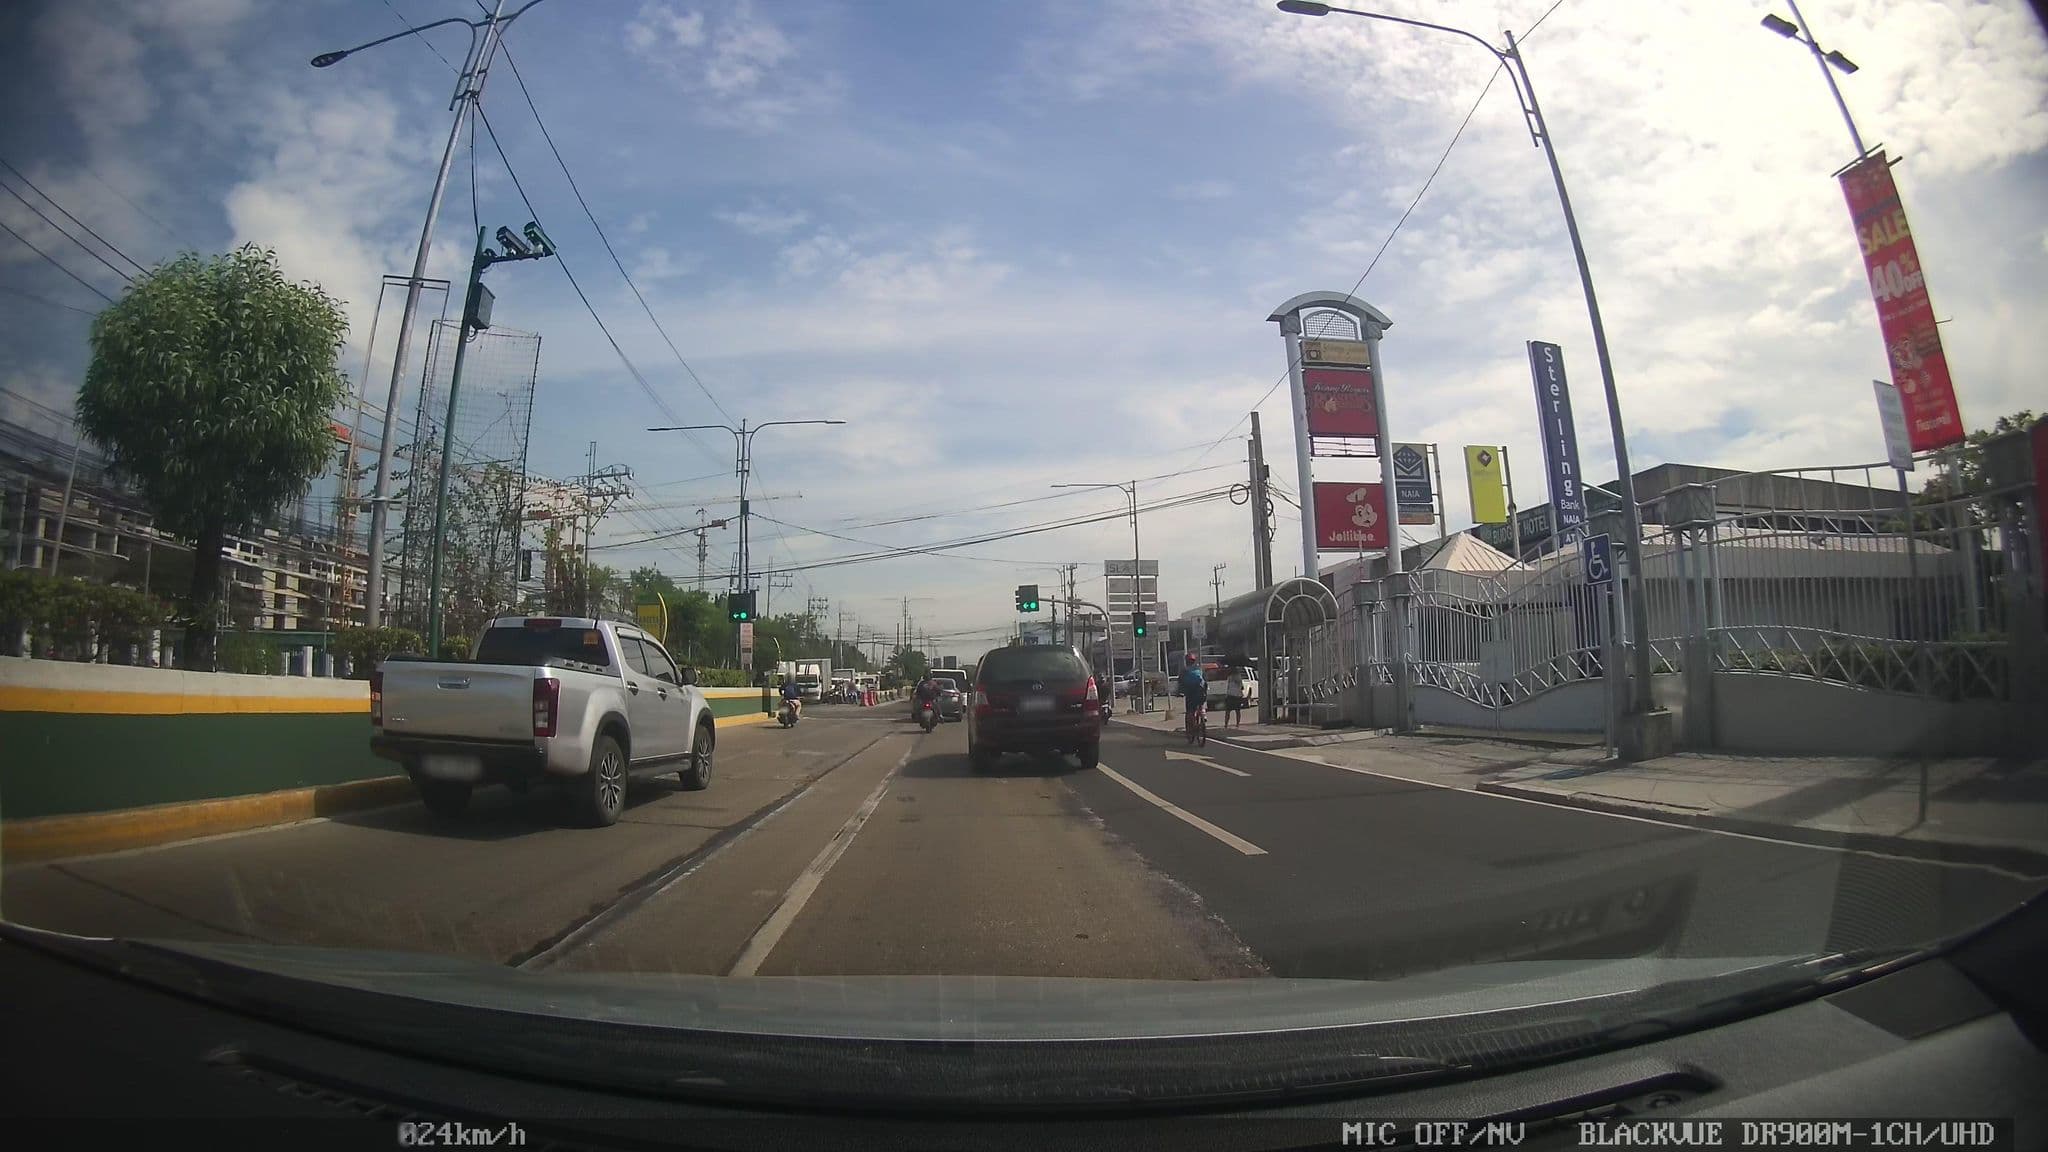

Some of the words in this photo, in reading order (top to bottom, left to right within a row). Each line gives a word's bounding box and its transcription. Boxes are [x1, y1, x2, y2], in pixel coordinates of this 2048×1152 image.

[1860, 209, 1910, 256] SALE
[1544, 347, 1573, 497] Sterling
[1401, 490, 1420, 498] NAIA
[1561, 499, 1580, 510] Bank
[1523, 515, 1549, 536] HOTEL
[1563, 515, 1580, 524] NAIA
